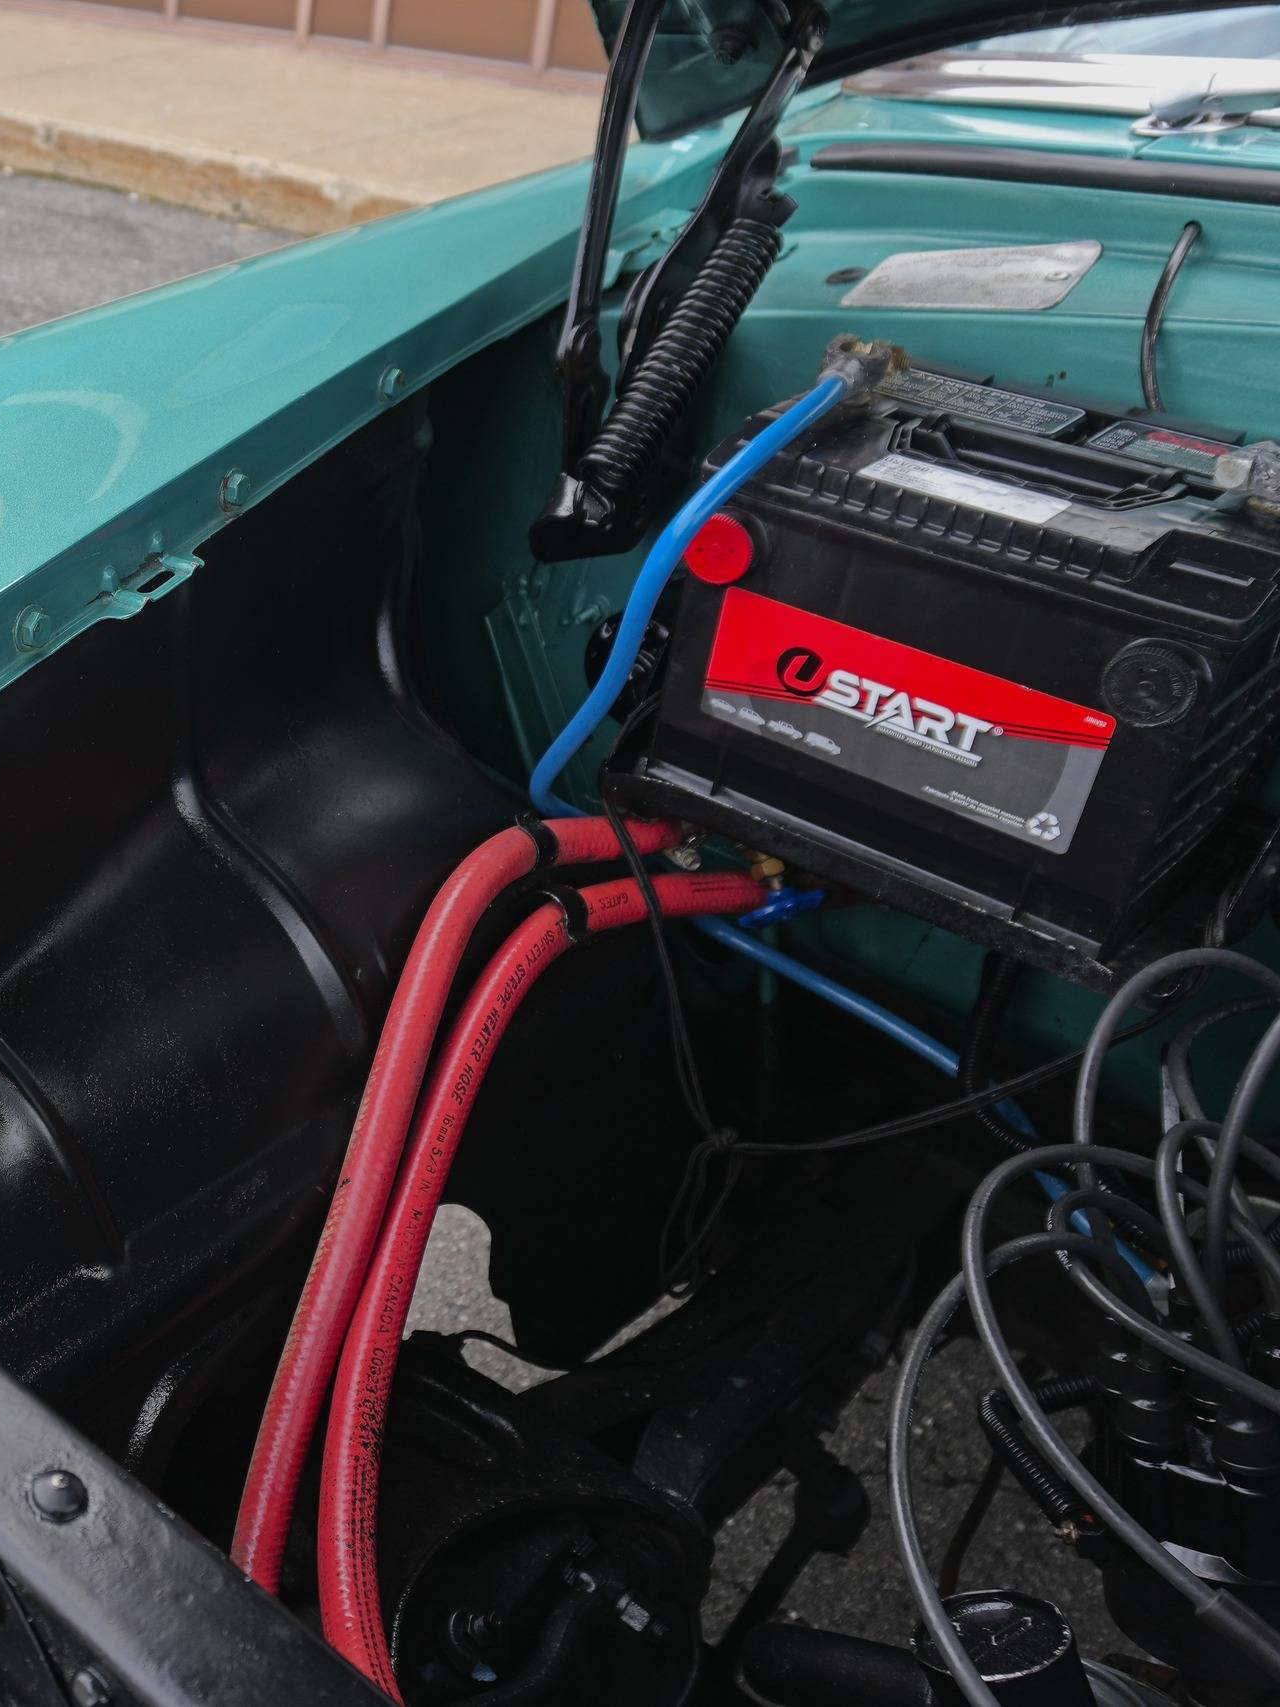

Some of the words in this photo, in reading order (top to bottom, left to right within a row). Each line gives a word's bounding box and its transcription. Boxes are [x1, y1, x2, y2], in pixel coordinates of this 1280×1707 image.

[600, 892, 628, 909] GATES
[526, 931, 555, 968] SAFETY
[496, 964, 527, 1010] STRIPE
[470, 1007, 500, 1063] HEATER
[451, 1063, 475, 1106] HOSE
[437, 1113, 455, 1143] 16mm
[377, 1274, 404, 1334] CANADA
